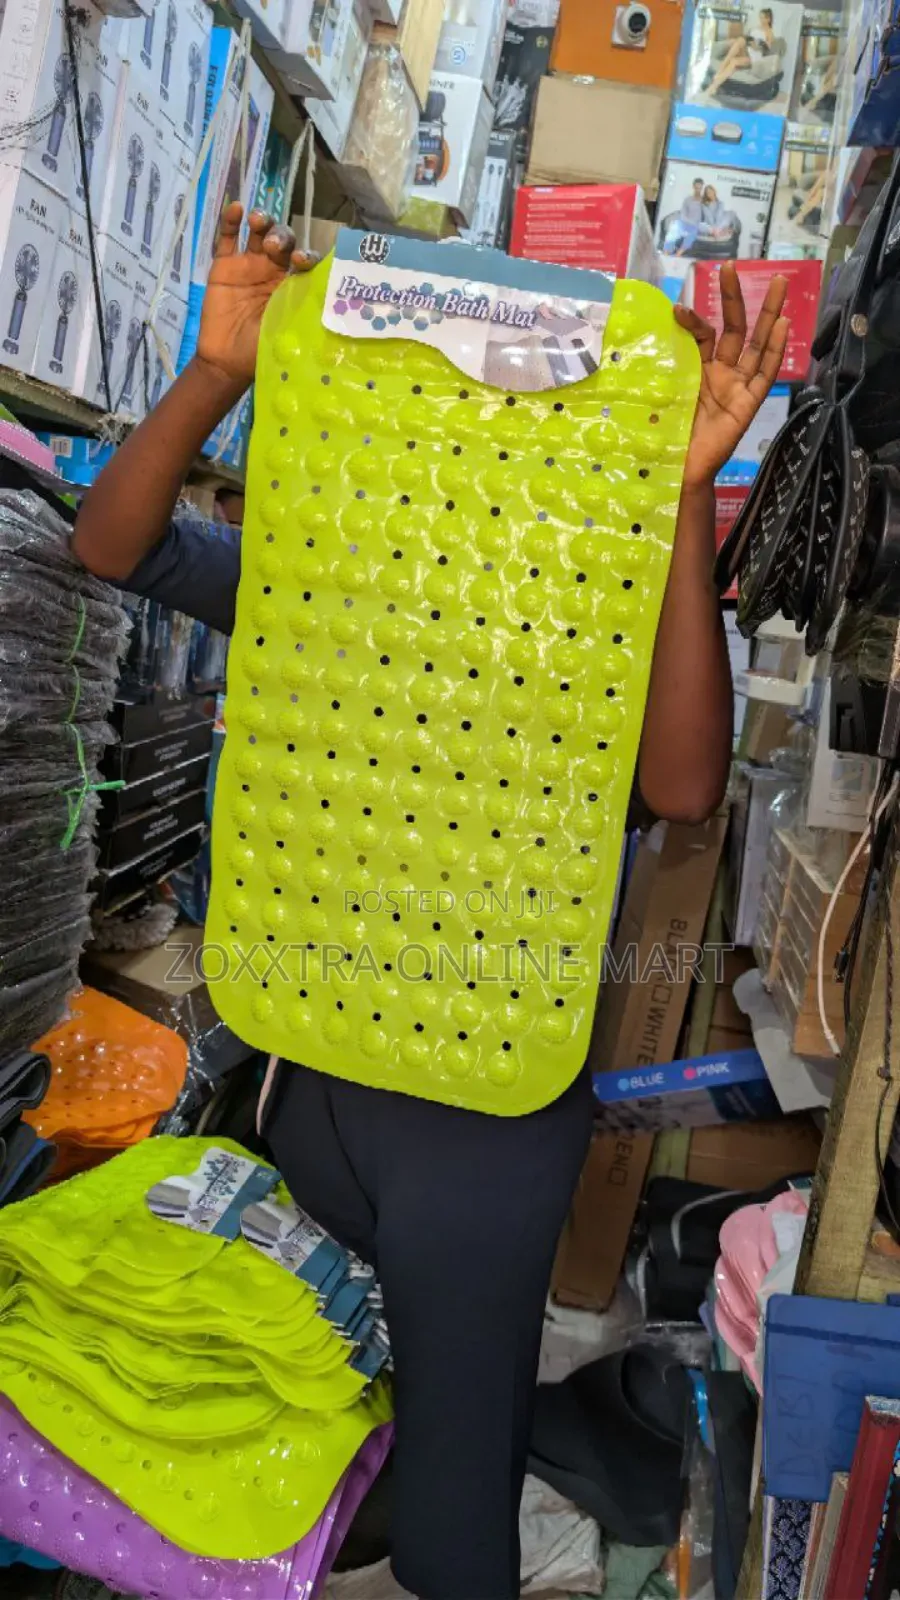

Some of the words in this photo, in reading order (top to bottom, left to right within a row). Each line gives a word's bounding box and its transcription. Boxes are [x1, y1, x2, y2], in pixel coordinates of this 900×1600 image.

[30, 198, 47, 218] FAN
[69, 227, 83, 246] FAN
[337, 276, 436, 309] Protection
[441, 293, 489, 320] Bath
[636, 1006, 667, 1066] WHITE
[630, 1071, 665, 1089] BLUE
[696, 1062, 730, 1077] PINK
